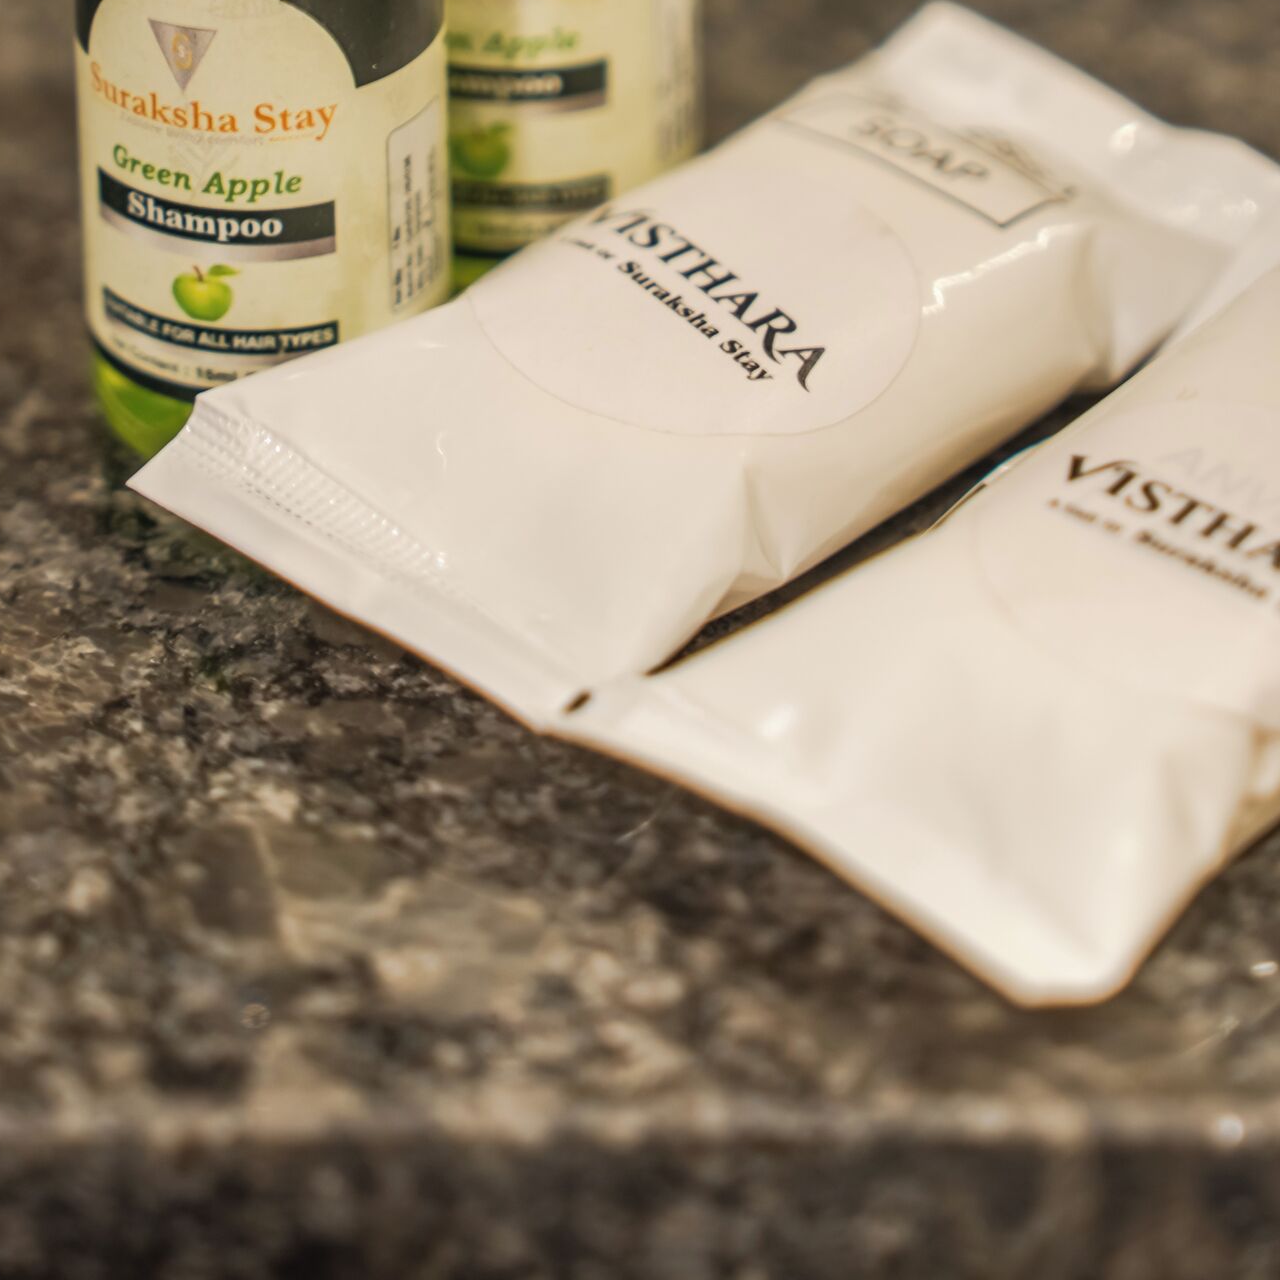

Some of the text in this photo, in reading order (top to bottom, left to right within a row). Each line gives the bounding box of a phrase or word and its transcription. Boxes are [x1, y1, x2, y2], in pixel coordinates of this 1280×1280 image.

[89, 61, 238, 133] Suraksha
[253, 102, 338, 141] Stay
[113, 145, 302, 203] Green Apple
[127, 191, 283, 242] Shampoo
[590, 207, 826, 392] VISTHARA
[617, 260, 774, 383] Suraksha Stay
[161, 322, 334, 350] FOR ALL HAIR TYPES
